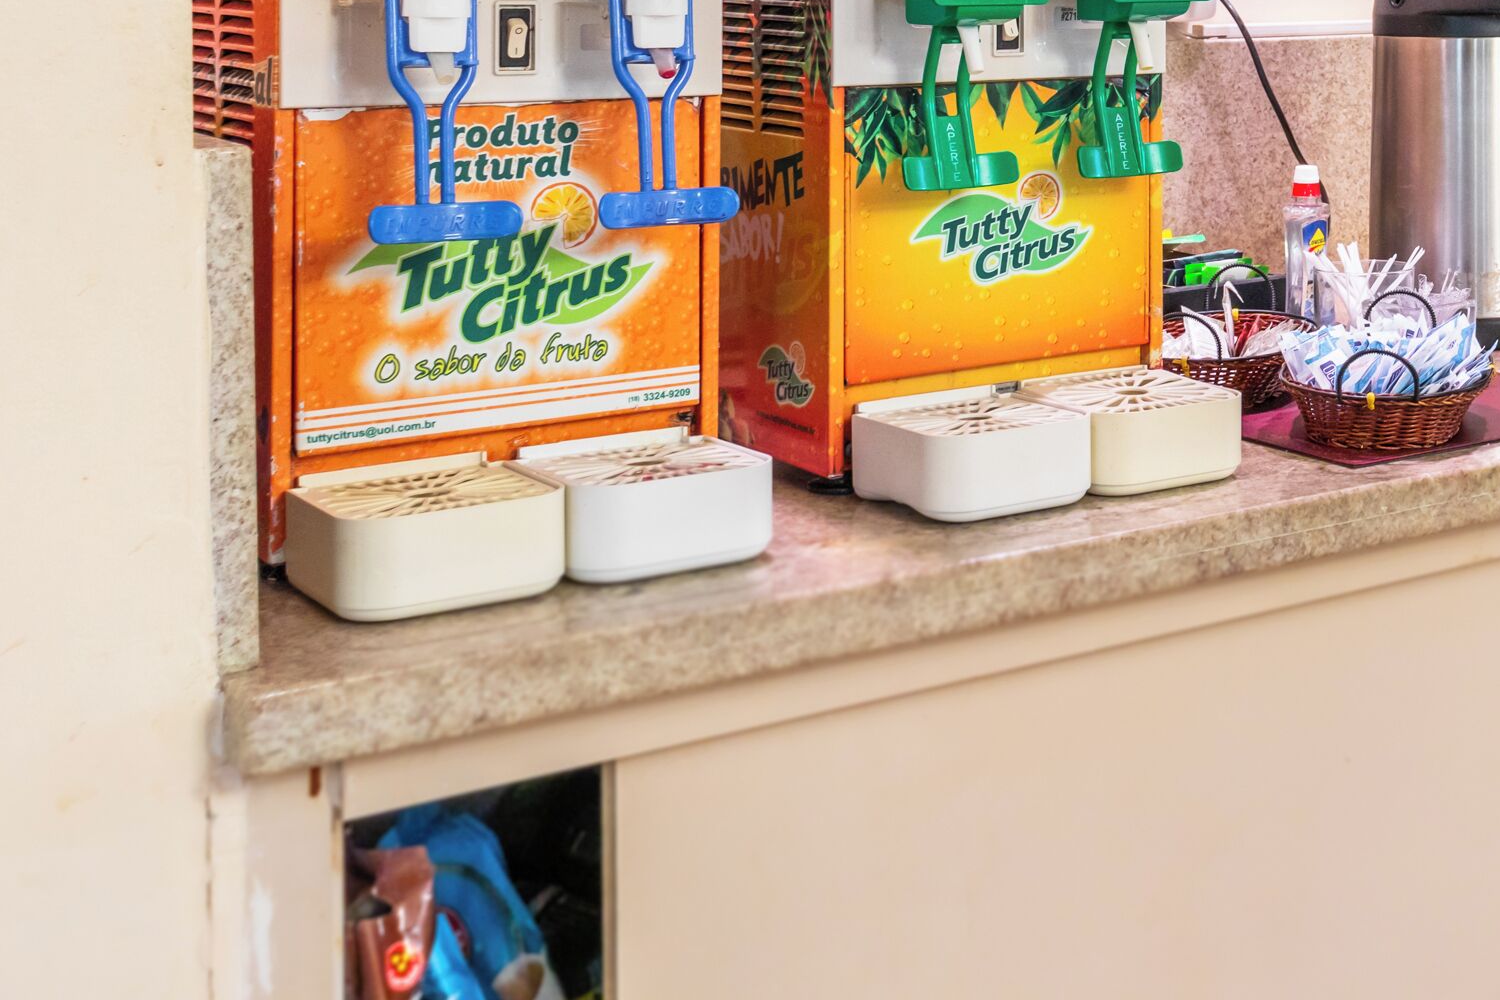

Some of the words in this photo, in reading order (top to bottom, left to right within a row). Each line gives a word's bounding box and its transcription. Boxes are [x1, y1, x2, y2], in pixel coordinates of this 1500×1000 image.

[427, 113, 579, 150] Produto
[946, 122, 961, 182] APERTE
[1115, 113, 1130, 170] APERTE
[427, 144, 573, 184] natural
[943, 204, 1032, 254] Tutty
[975, 228, 1075, 280] Citrus
[399, 224, 557, 312] Tutty
[461, 253, 631, 343] Citrus
[374, 353, 400, 384] O
[414, 345, 487, 381] sabor
[495, 342, 526, 372] da
[540, 332, 609, 364] fruta
[766, 359, 795, 380] Tutty
[643, 388, 691, 402] 3324-9209
[776, 381, 809, 401] Citrus
[306, 419, 436, 444] tuttycitrus@uol.com.br
